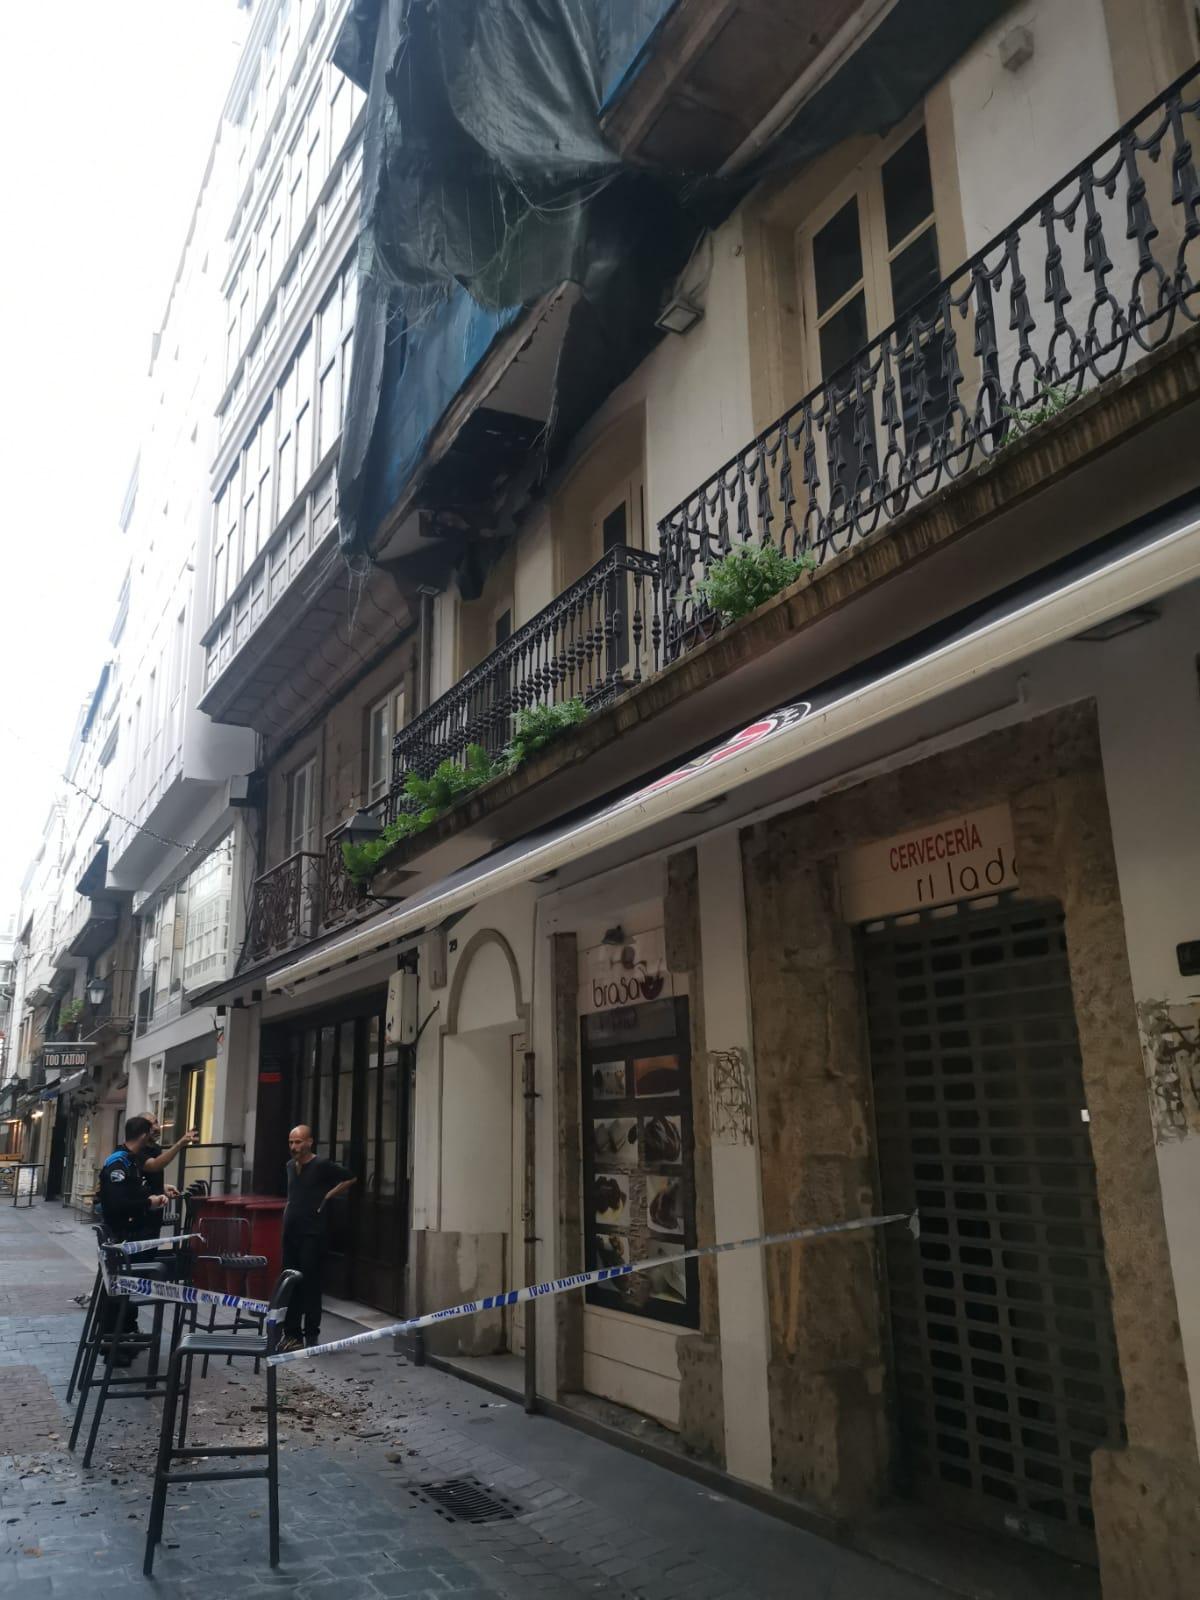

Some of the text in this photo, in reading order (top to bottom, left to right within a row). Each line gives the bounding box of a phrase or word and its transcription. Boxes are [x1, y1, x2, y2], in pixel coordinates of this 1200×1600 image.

[889, 819, 983, 873] CERVECERÍA
[45, 1053, 86, 1066] TOO TATTOO
